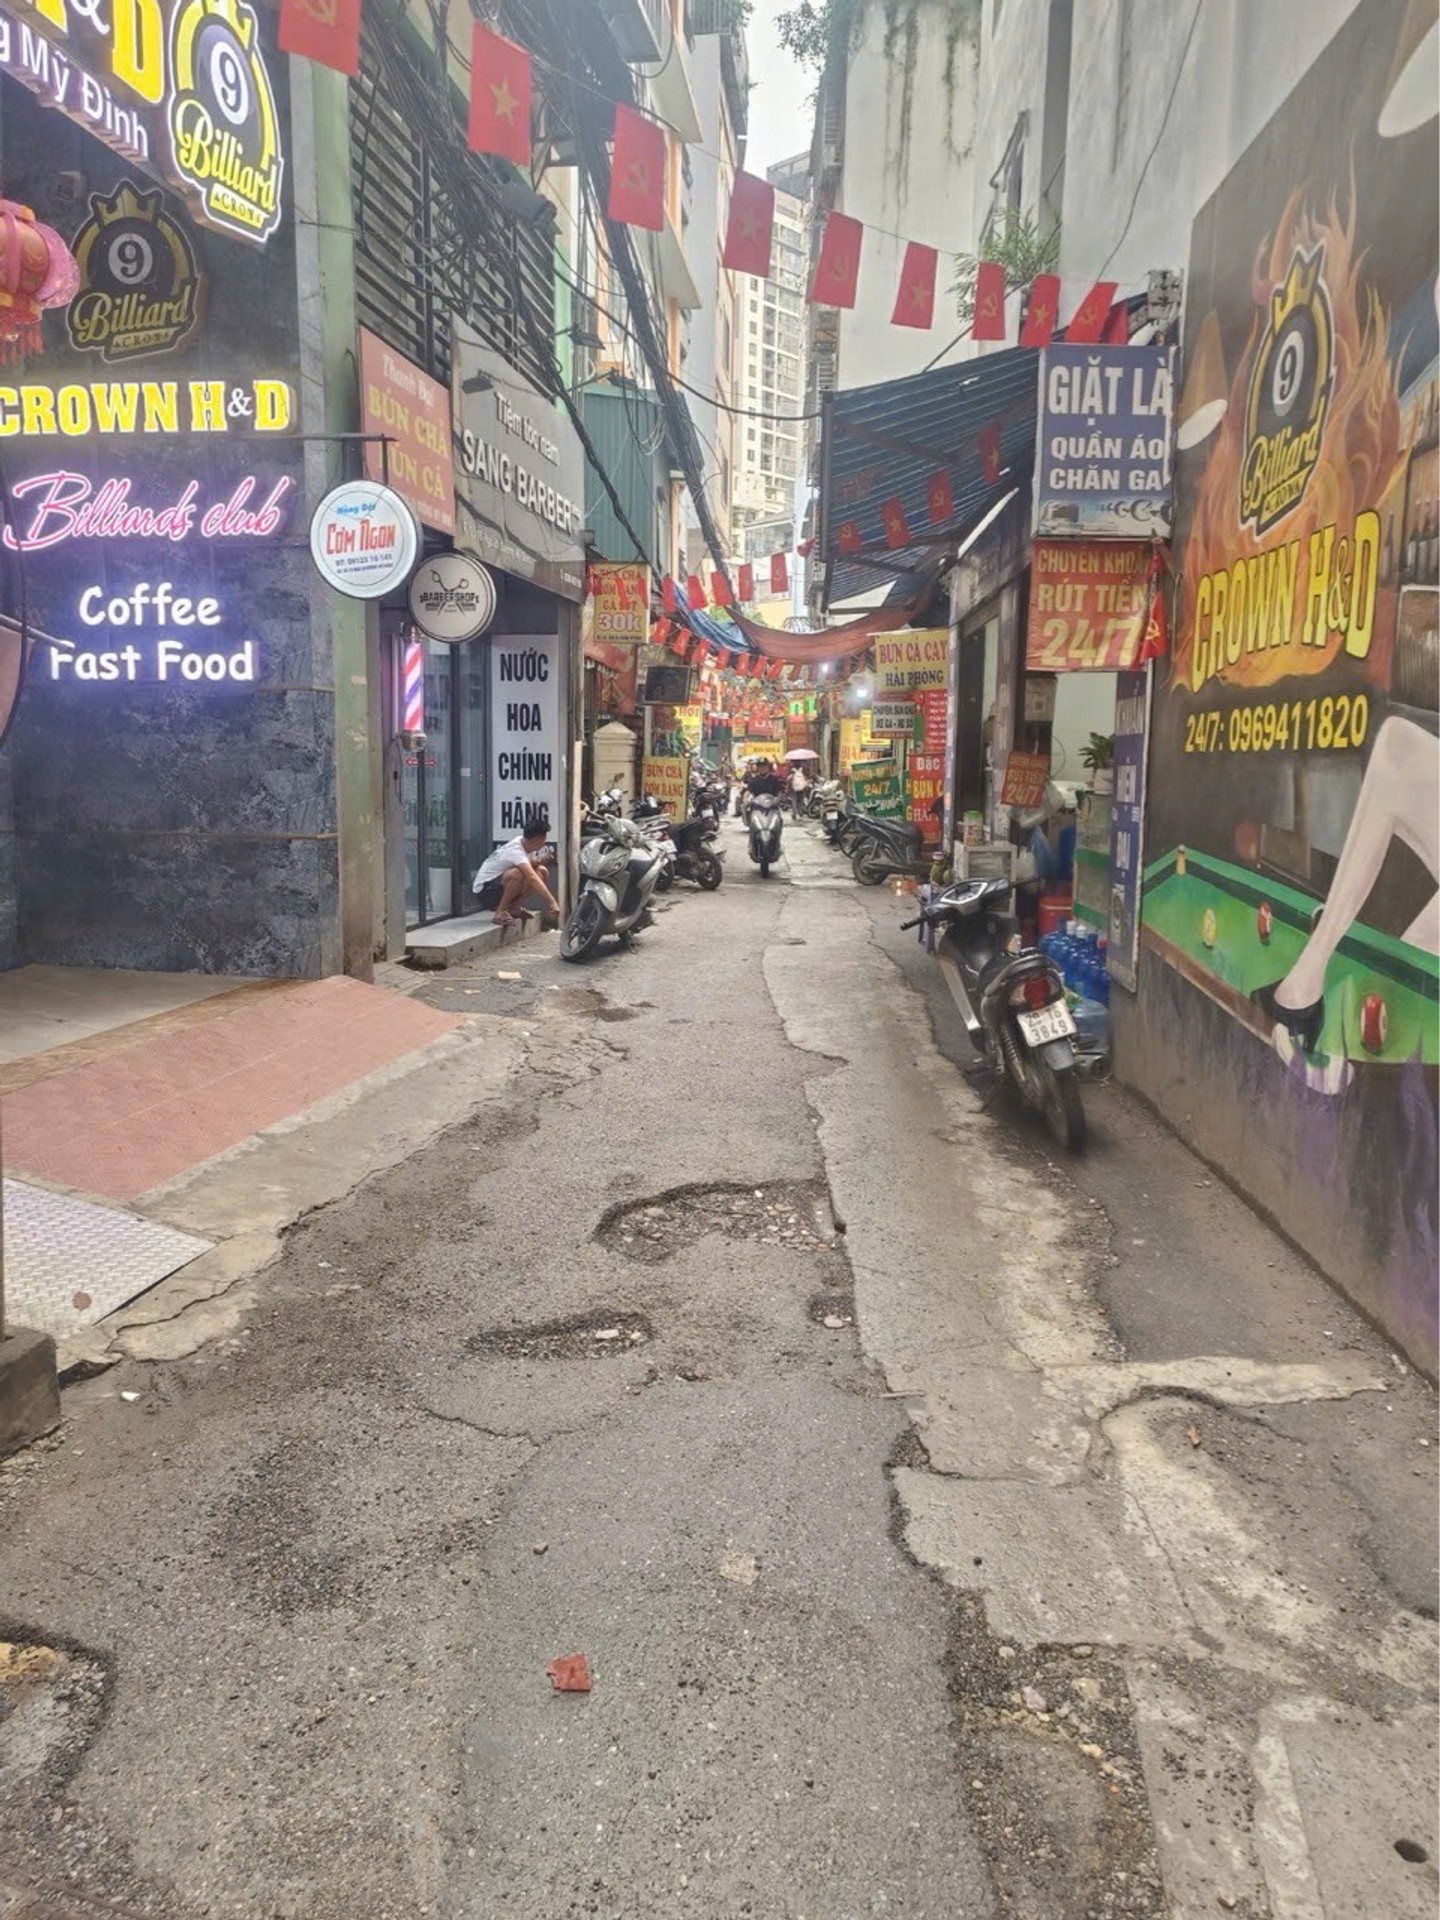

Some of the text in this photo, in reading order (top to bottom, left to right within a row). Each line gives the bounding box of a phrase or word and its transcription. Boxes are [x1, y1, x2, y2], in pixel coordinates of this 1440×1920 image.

[22, 23, 69, 102] Mỹ
[82, 72, 148, 157] Đình
[176, 99, 278, 212] Billiard
[73, 284, 191, 344] Billiard
[0, 379, 291, 436] CROWN H&D
[367, 384, 410, 433] BÚN
[1048, 356, 1173, 426] GIẶT LÀ
[461, 428, 513, 494] SANG
[1051, 430, 1165, 461] QUẦN ÁO
[1242, 402, 1324, 517] Billiard
[1049, 464, 1163, 491] CHĂN GA
[3, 470, 290, 551] Billiards club
[79, 582, 222, 626] Coffee
[1037, 576, 1149, 613] RÚT TIỀN
[1191, 510, 1380, 693] CROWN H&D
[51, 639, 254, 681] Fast Food
[499, 647, 549, 682] NƯỚC
[879, 636, 948, 664] BÚN CÁ CAY
[1039, 614, 1146, 668] 24/7
[886, 666, 945, 687] HẢI PHÒNG
[507, 703, 542, 732] HOA
[1186, 694, 1368, 753] 24/7: 0969411820
[498, 747, 553, 782] CHÍNH
[501, 796, 550, 829] HÃNG
